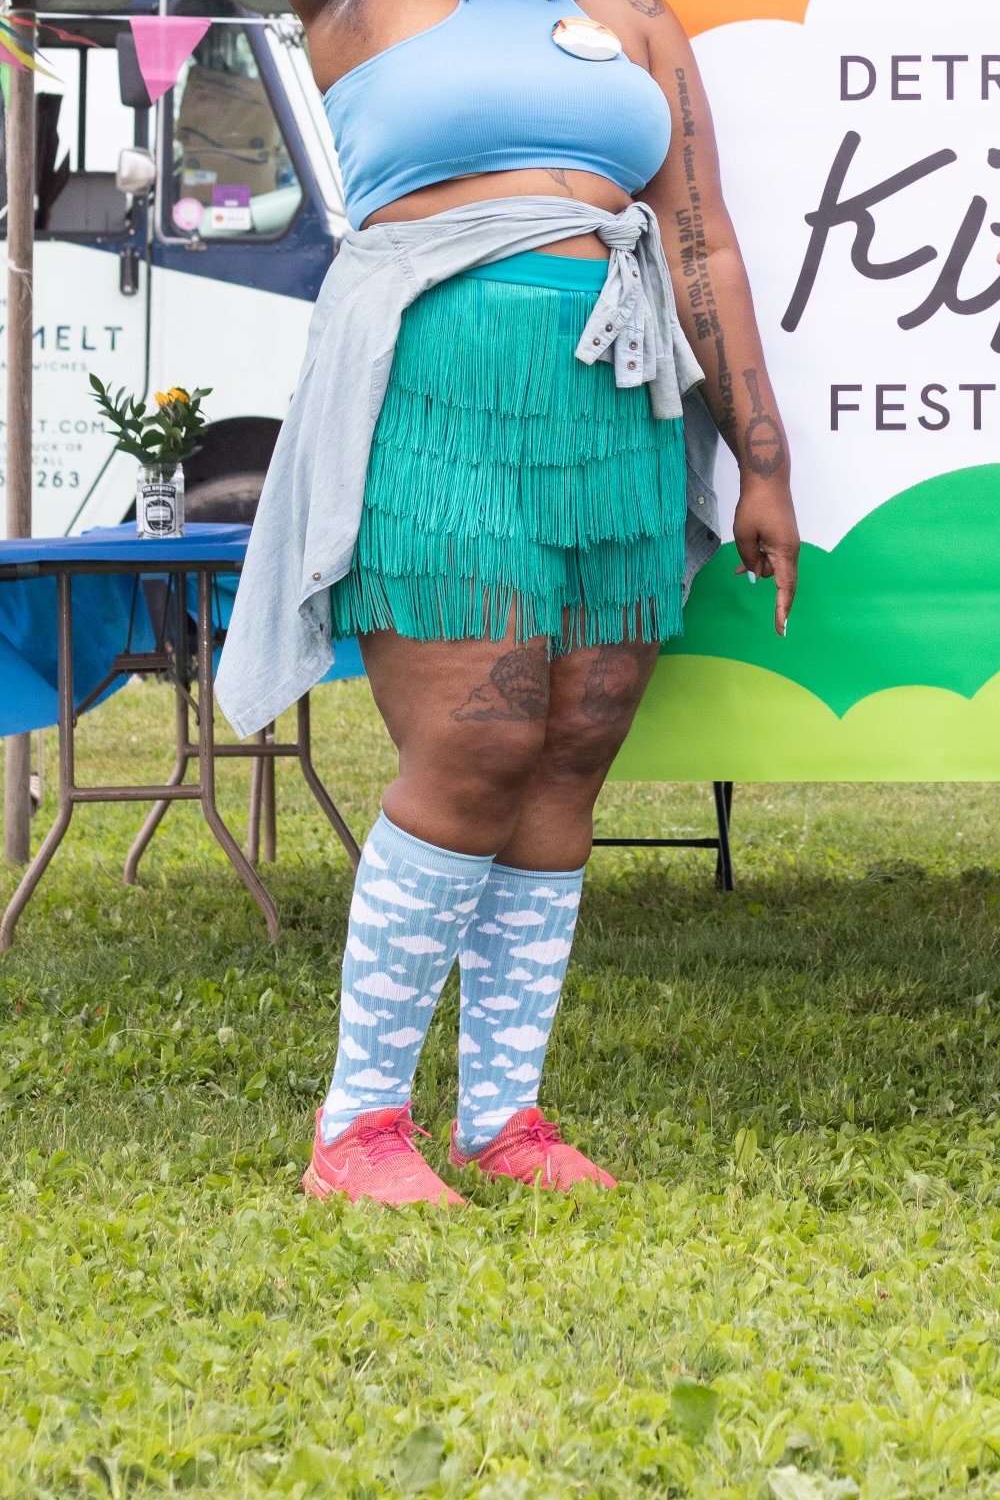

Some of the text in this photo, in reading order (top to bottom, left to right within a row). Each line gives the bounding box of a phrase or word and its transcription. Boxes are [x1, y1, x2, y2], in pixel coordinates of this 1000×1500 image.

[675, 208, 711, 341] LOVE WHO YOU ARE
